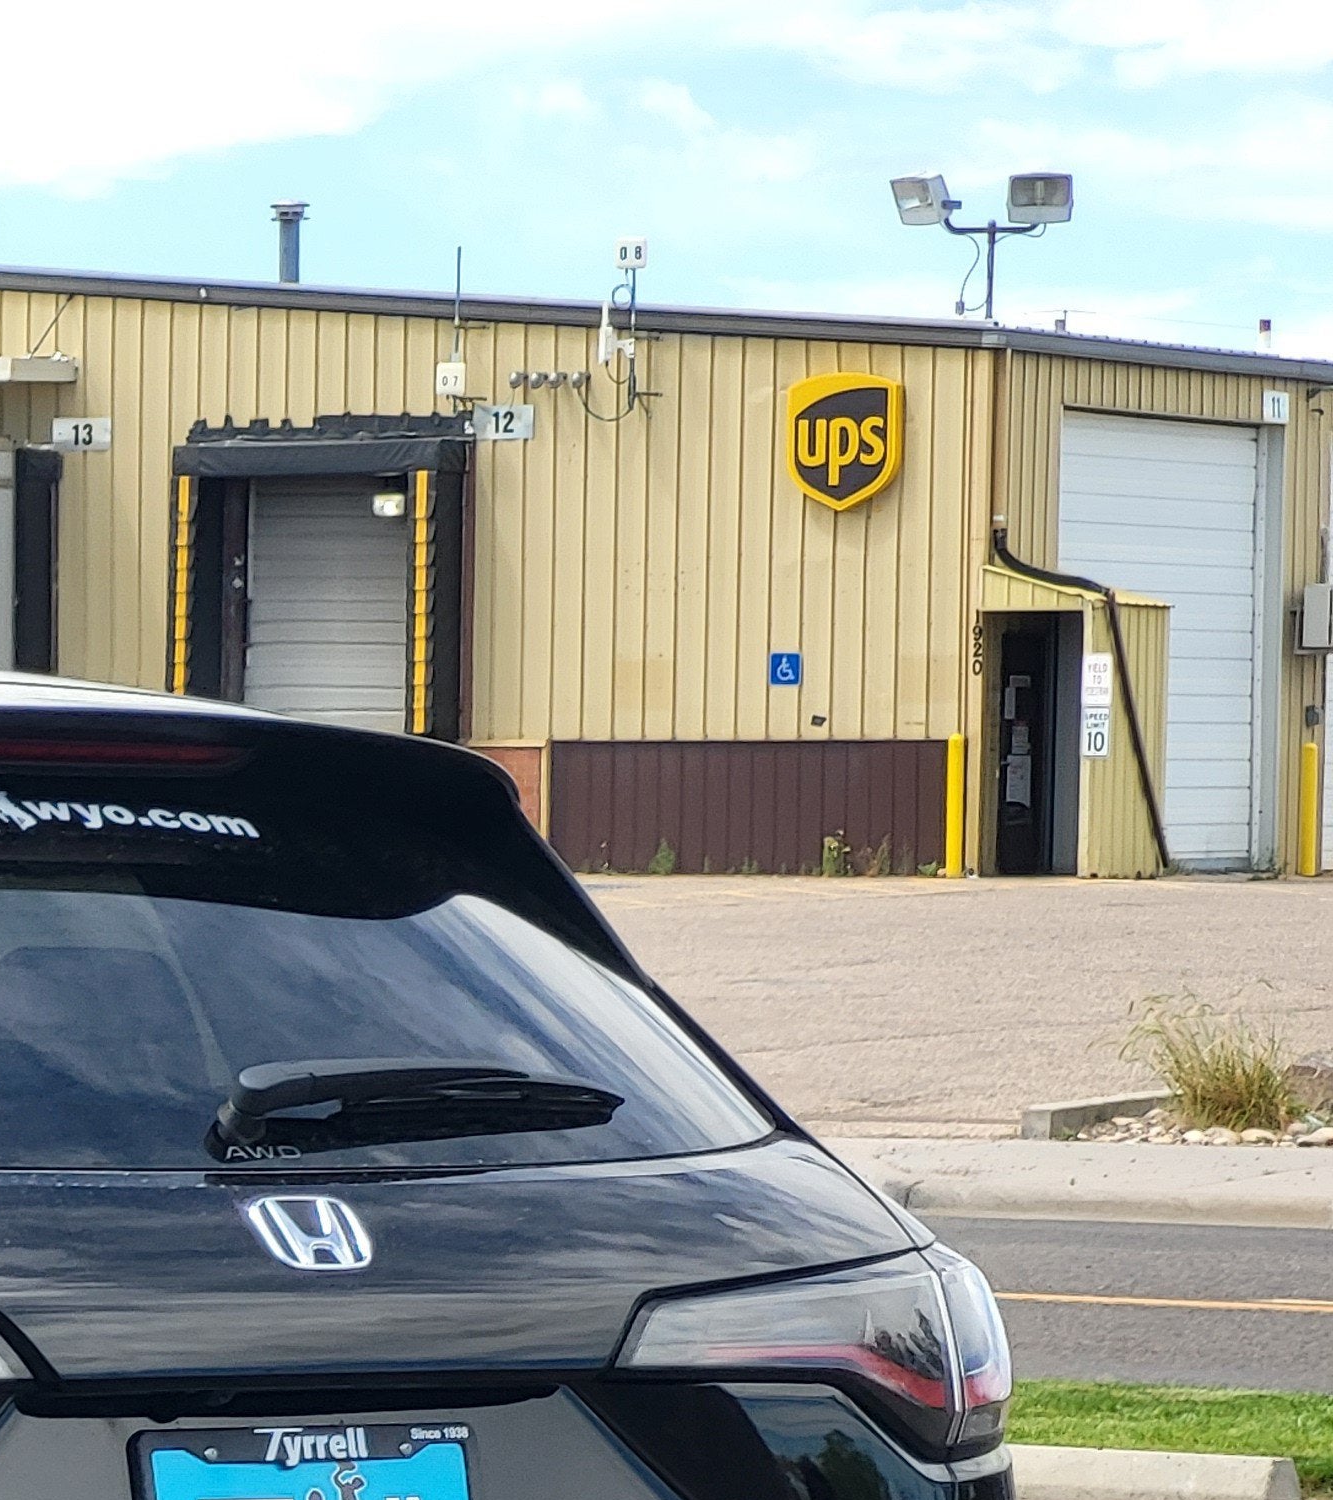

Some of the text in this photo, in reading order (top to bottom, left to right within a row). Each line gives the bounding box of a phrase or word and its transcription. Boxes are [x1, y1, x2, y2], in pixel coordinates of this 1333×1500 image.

[1271, 396, 1281, 418] 11
[492, 411, 515, 433] 12
[72, 423, 93, 446] 13
[797, 416, 886, 486] ups
[1087, 731, 1105, 752] 10
[225, 1145, 302, 1161] AWD
[410, 1428, 442, 1441] Since
[253, 1426, 369, 1467] Tyrrell
